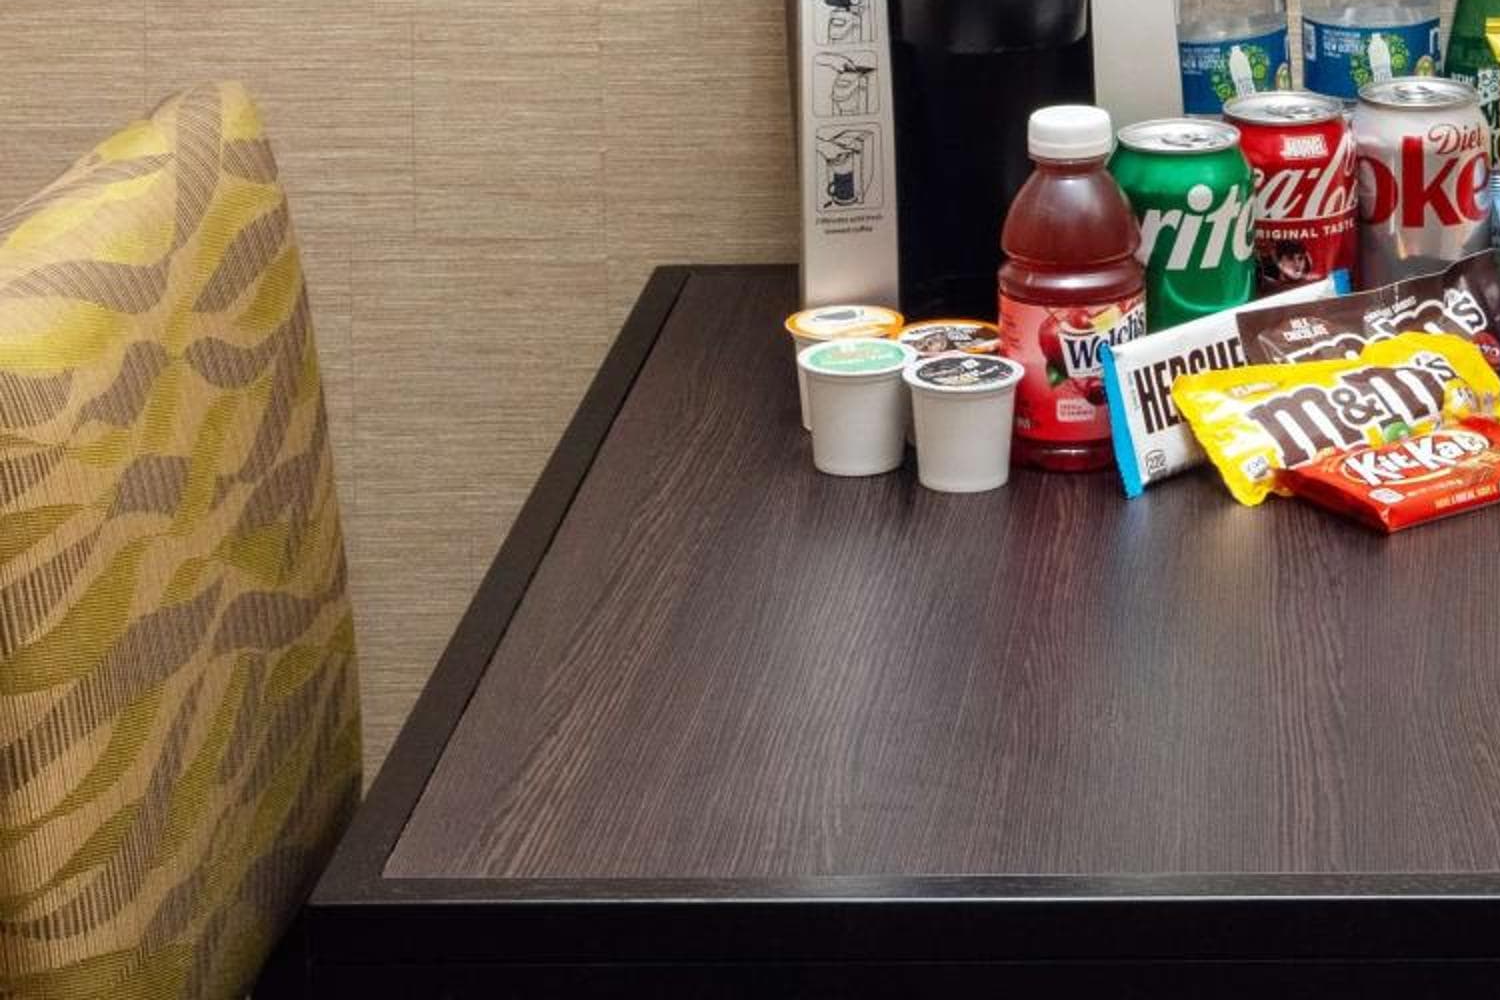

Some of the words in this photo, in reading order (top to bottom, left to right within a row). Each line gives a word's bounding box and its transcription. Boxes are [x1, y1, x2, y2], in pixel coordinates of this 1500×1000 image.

[1356, 136, 1490, 228] oke
[1136, 184, 1254, 271] rite
[1254, 226, 1319, 240] RIGINAL
